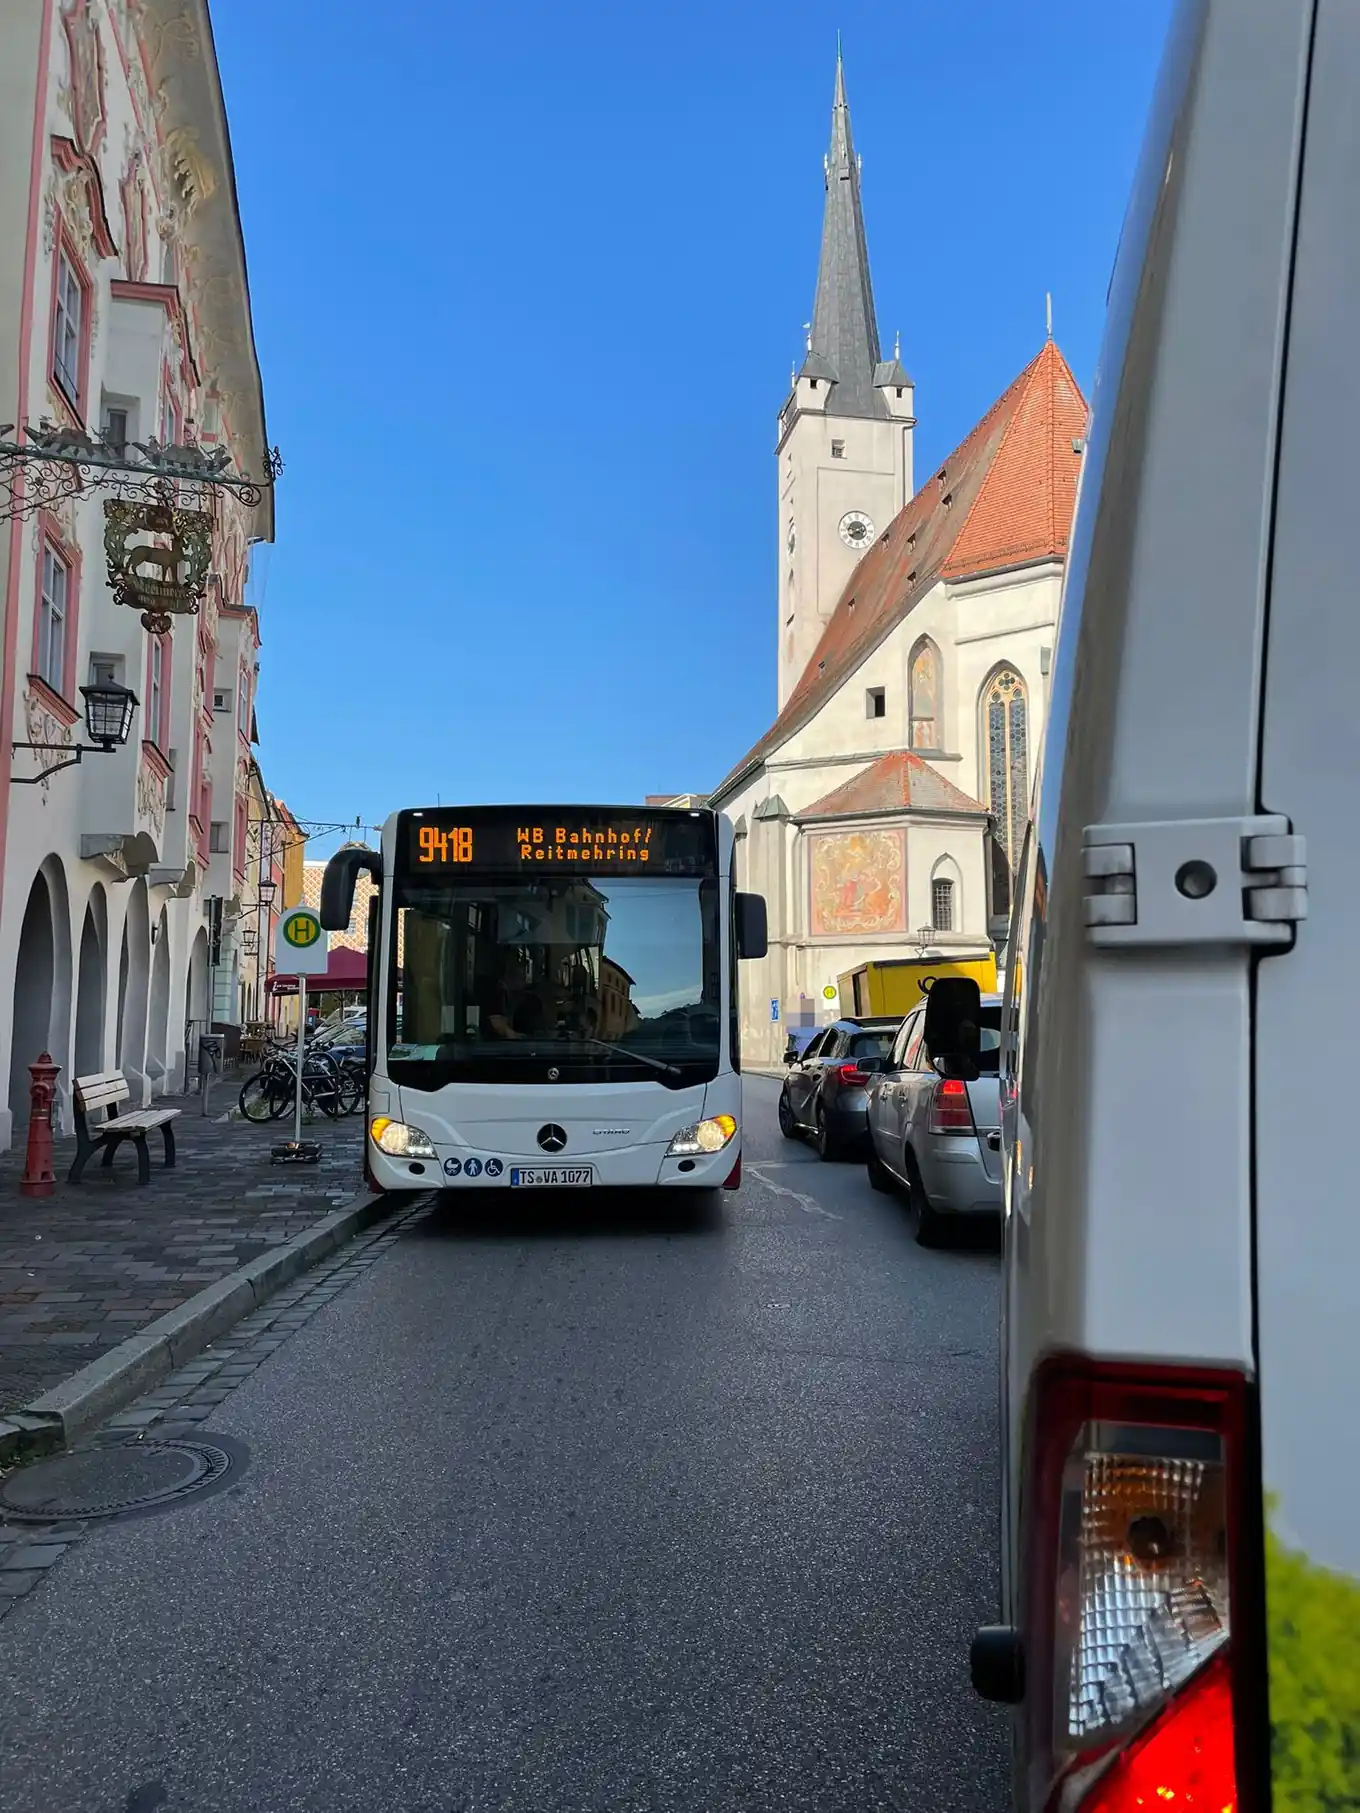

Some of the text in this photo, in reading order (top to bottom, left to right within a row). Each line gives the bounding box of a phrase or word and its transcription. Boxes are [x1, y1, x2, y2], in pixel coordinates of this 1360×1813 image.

[517, 827, 652, 844] WB Bahnhof/
[419, 827, 473, 863] 9418
[520, 844, 649, 861] Reitmehring
[294, 919, 310, 940] H
[519, 1170, 590, 1184] TS VA 1077
